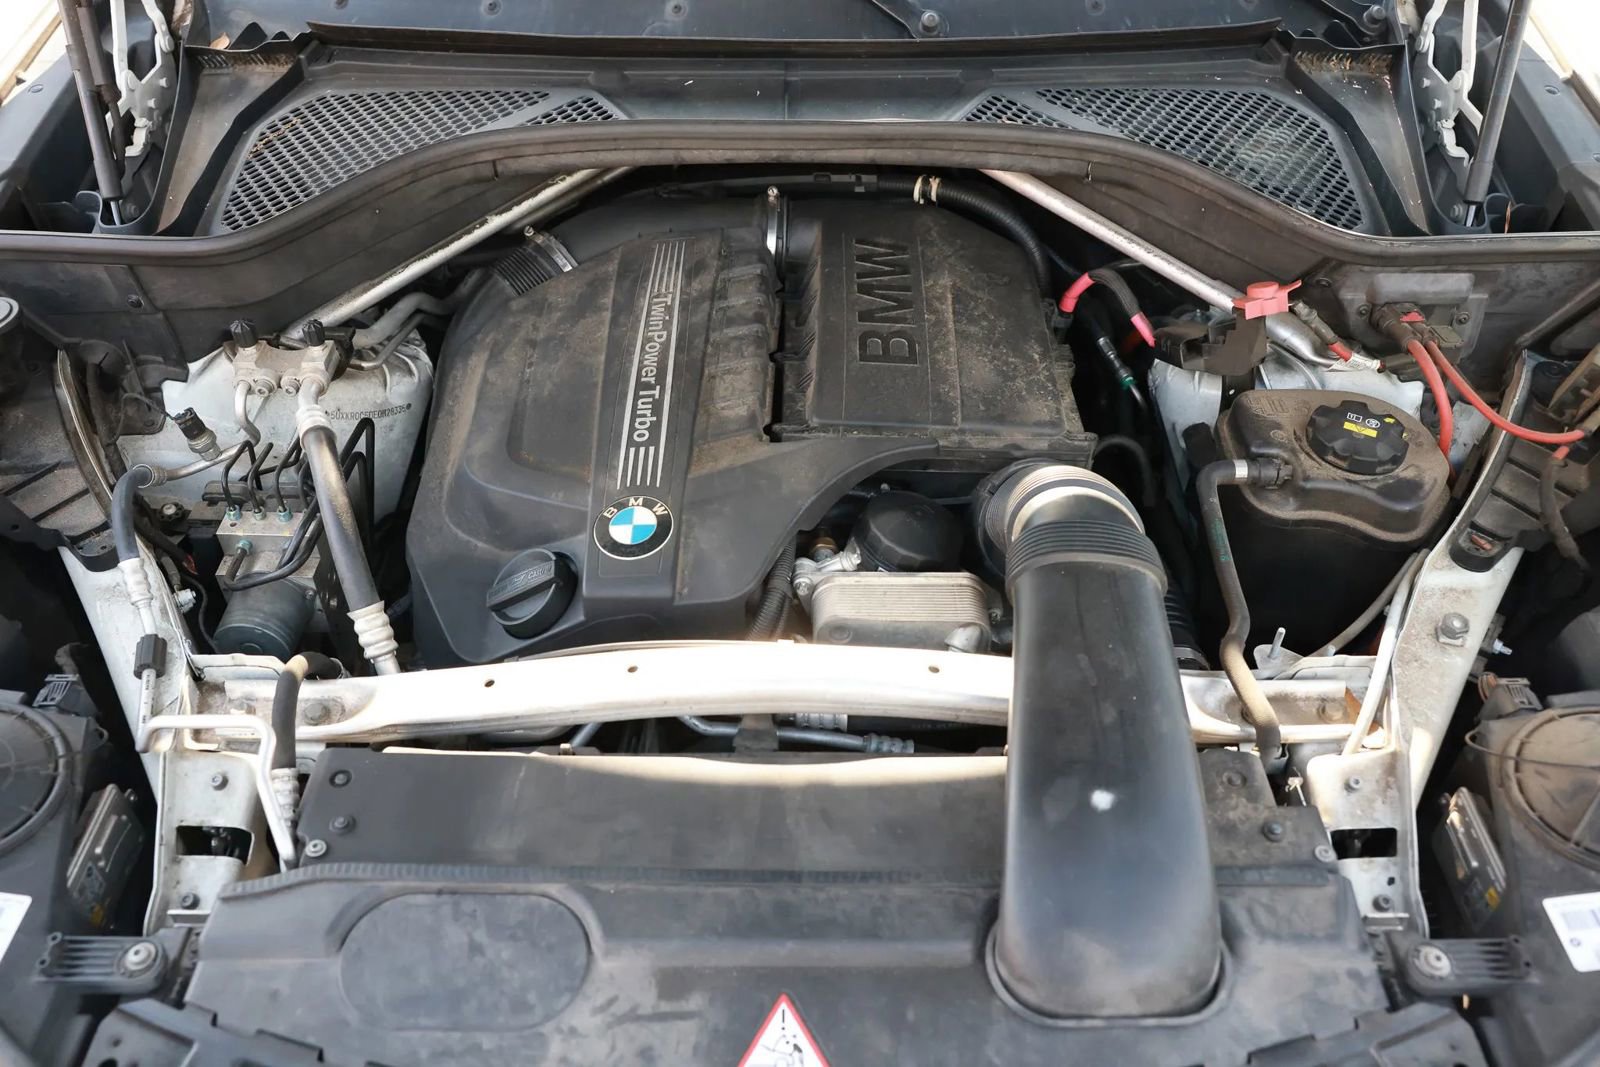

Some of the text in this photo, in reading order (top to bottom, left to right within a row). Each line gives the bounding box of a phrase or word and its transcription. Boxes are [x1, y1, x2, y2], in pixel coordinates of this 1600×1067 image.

[854, 239, 919, 366] BMW
[633, 293, 672, 442] TwinPower Turbo
[603, 497, 668, 518] BMW
